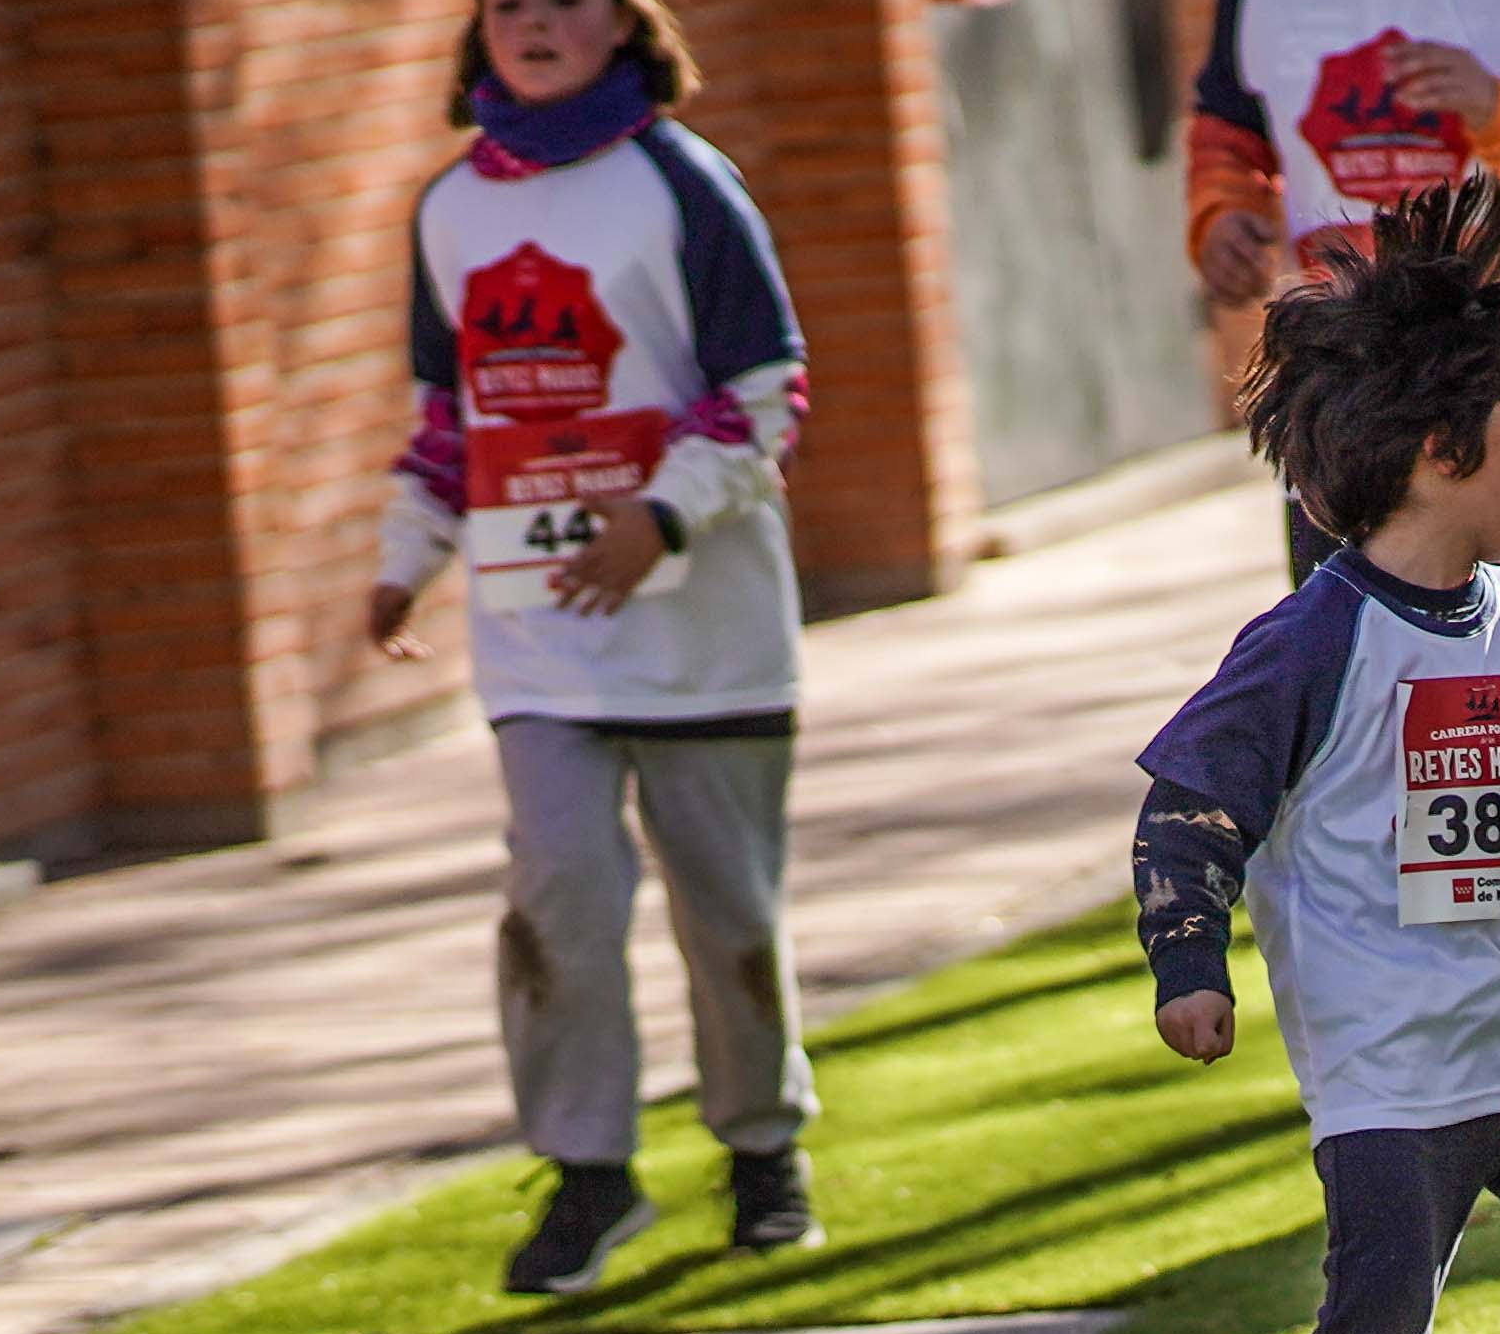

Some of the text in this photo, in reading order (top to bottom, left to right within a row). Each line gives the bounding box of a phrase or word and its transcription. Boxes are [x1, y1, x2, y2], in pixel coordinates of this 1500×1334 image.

[525, 508, 596, 553] 44
[1430, 724, 1487, 741] CARRERA
[1408, 747, 1482, 783] REYES
[1477, 890, 1493, 902] de
